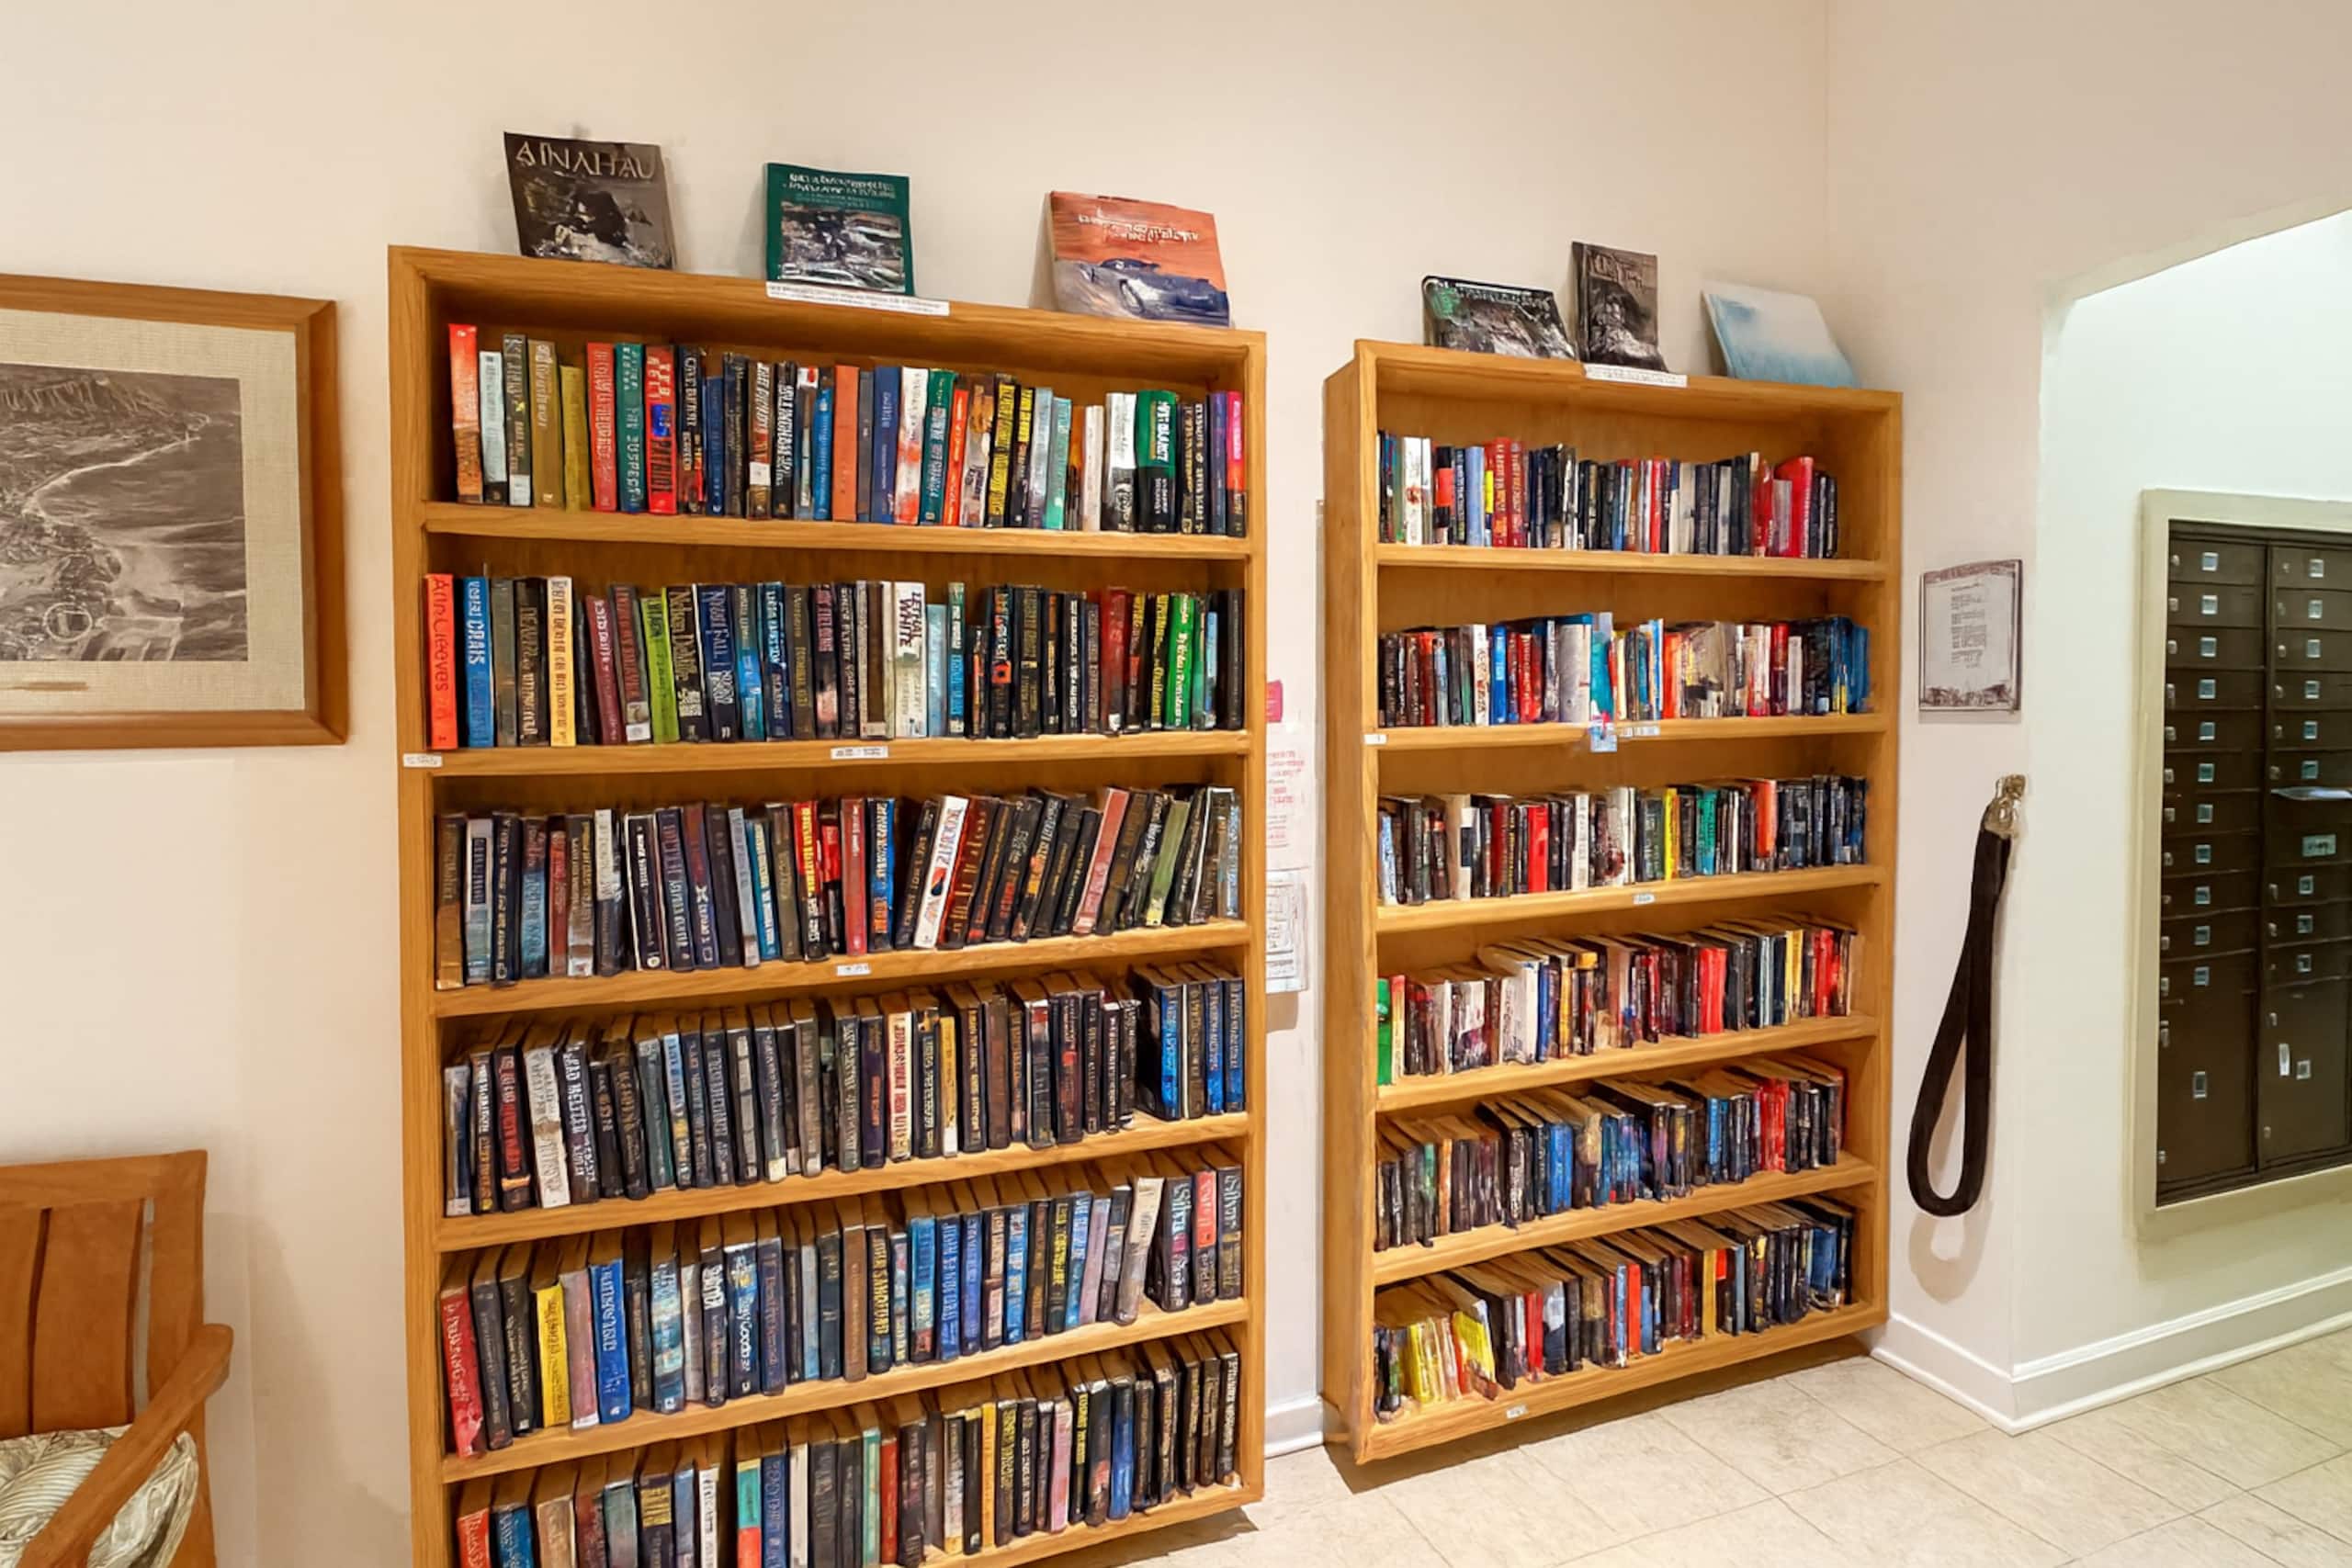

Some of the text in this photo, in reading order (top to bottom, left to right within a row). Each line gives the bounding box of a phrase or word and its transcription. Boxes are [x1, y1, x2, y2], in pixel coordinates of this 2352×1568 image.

[899, 598, 912, 647] WHITE
[911, 592, 922, 638] LETHAL
[468, 620, 485, 665] CRAIS
